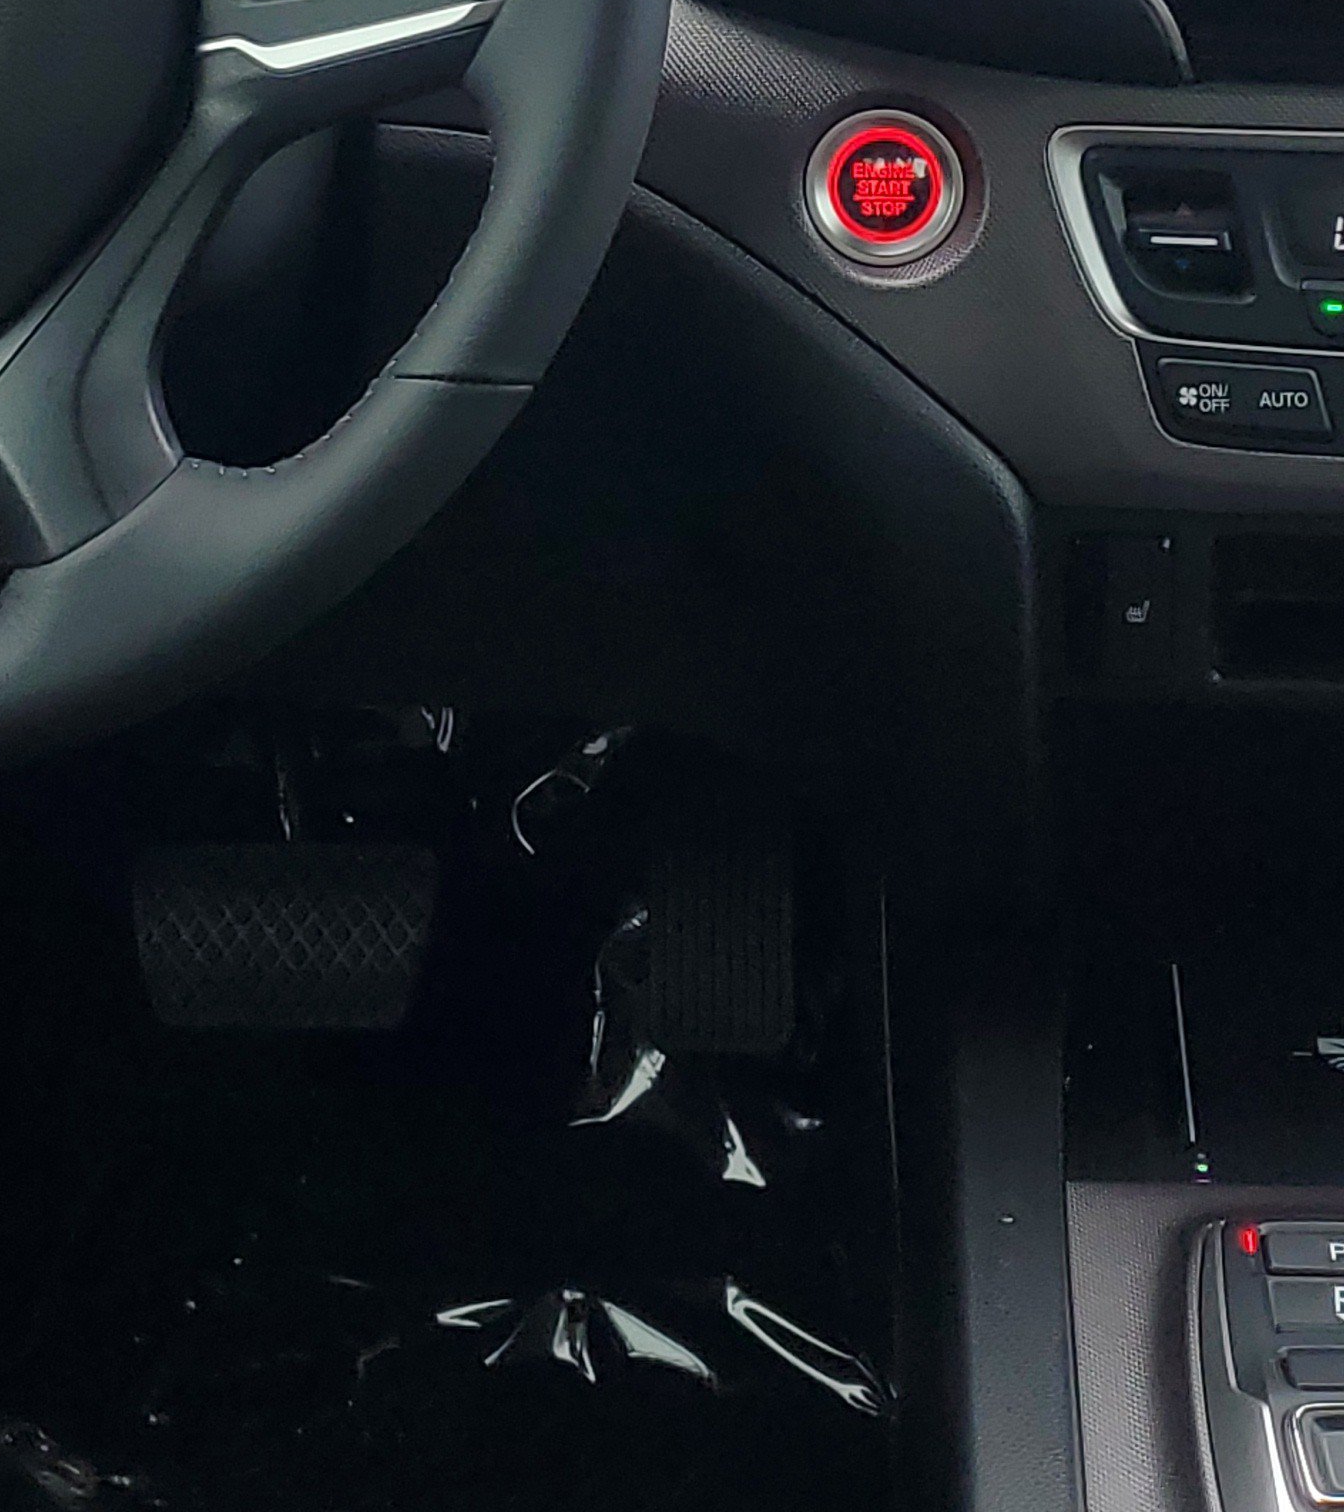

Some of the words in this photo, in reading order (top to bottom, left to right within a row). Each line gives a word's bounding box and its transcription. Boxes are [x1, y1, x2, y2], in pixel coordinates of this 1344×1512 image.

[852, 161, 916, 179] ENGINE
[857, 179, 911, 195] START
[860, 200, 907, 217] STOP
[1199, 383, 1229, 398] ON/
[1199, 398, 1230, 413] OFF
[1259, 391, 1309, 408] AUTO
